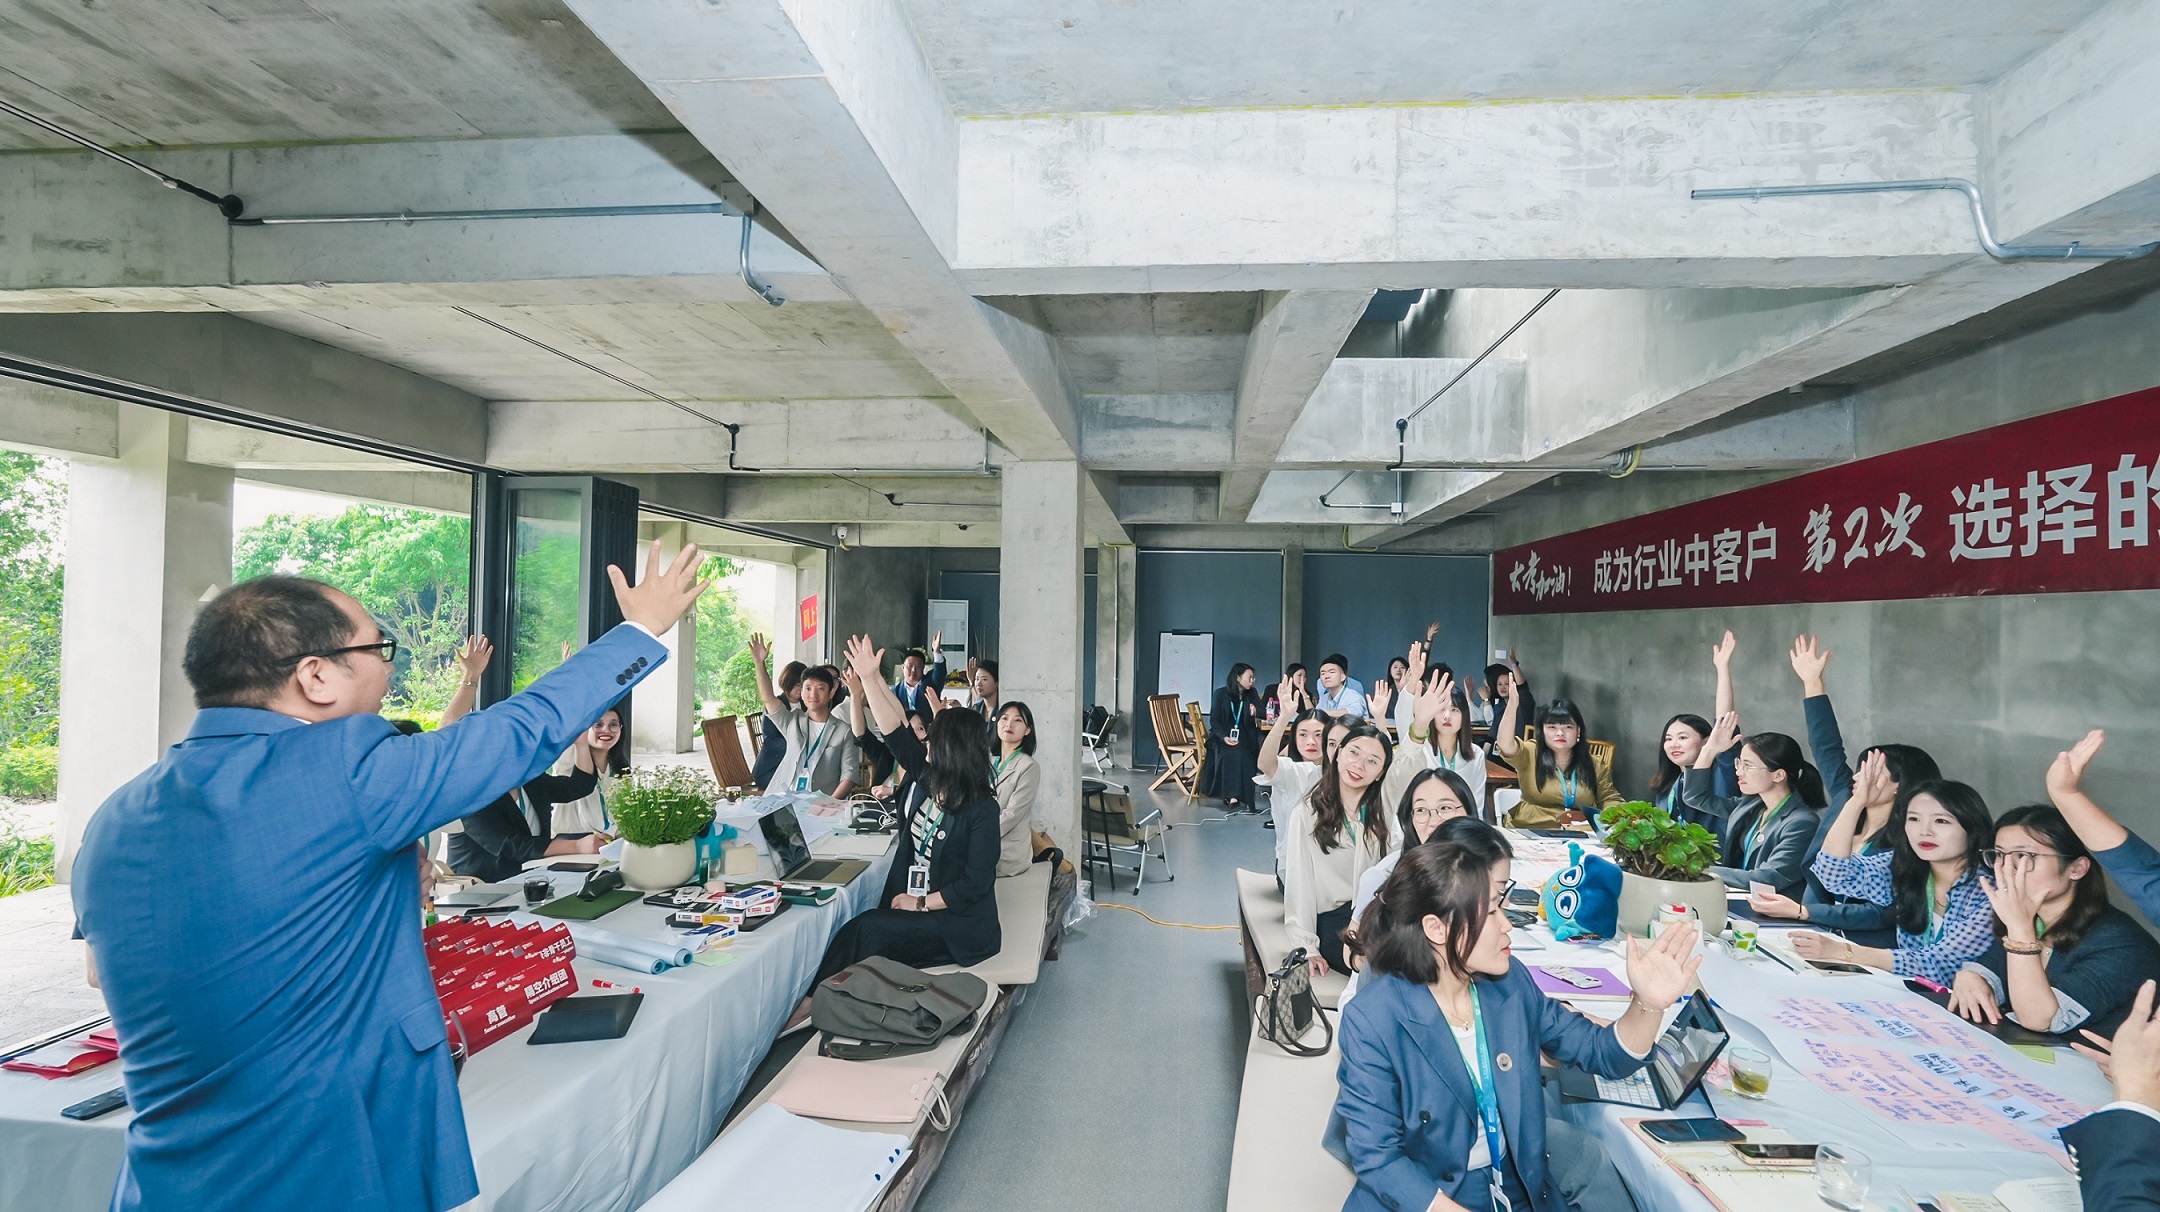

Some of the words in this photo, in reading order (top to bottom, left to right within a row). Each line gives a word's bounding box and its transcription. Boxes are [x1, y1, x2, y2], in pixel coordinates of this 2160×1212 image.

[1593, 521, 1777, 594] 成为行业中客户
[1801, 492, 1927, 573] 第2次
